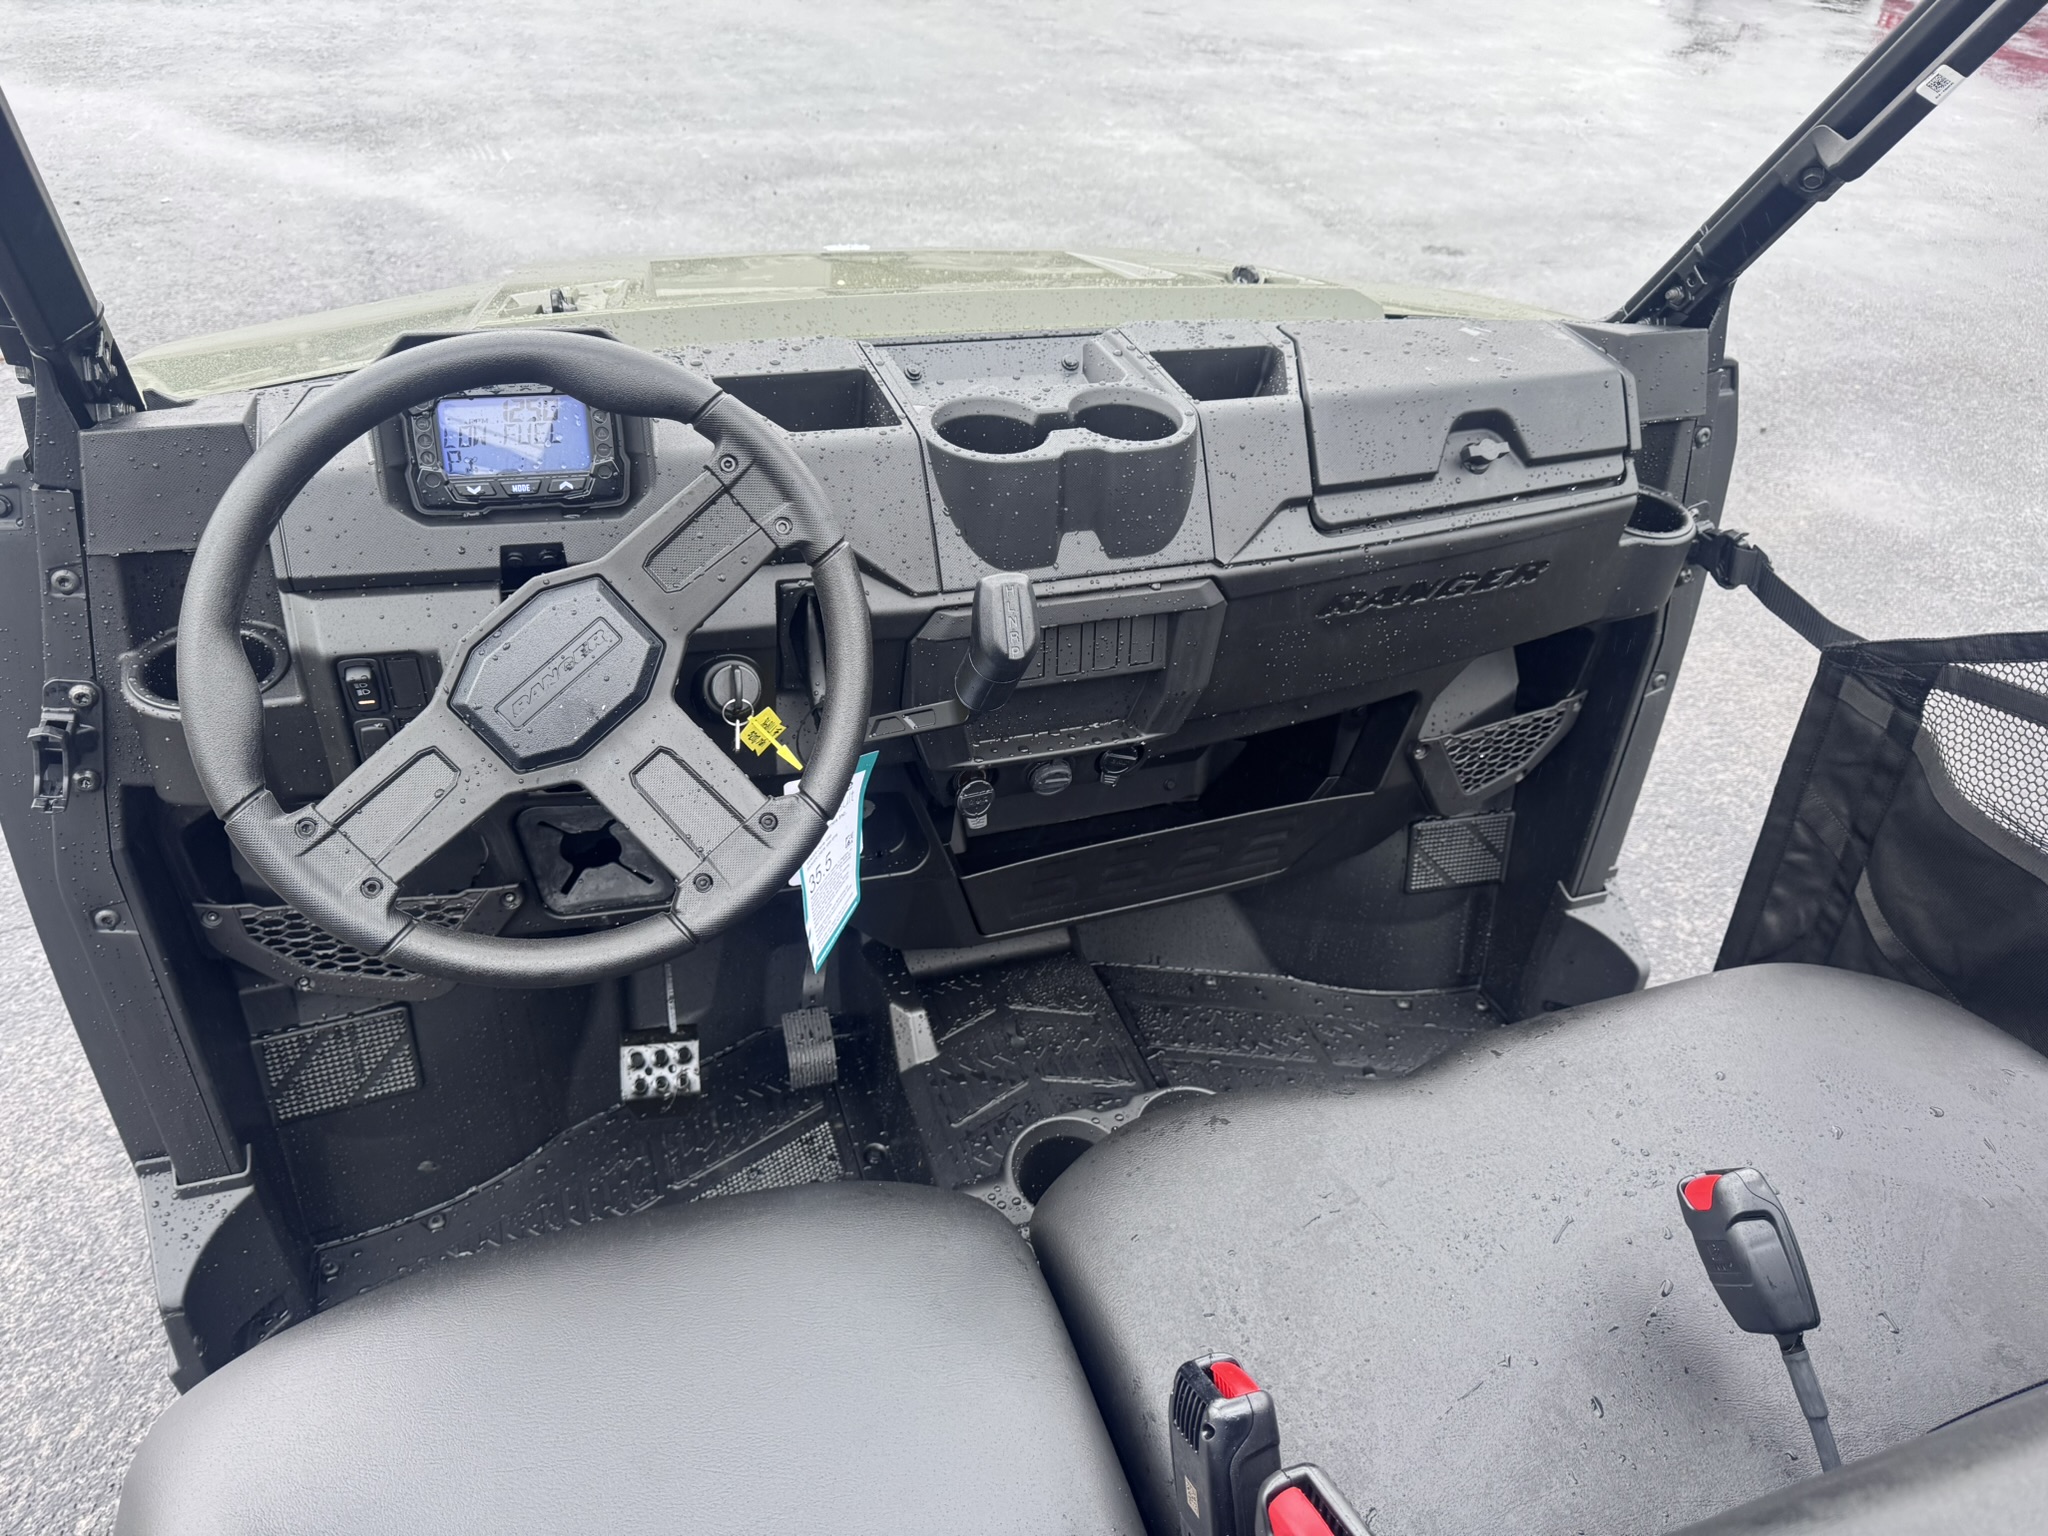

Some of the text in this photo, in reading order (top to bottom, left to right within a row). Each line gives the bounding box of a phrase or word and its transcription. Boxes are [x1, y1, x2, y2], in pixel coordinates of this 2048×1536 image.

[444, 422, 562, 448] LOW FUEL
[511, 484, 531, 493] MODE
[1314, 559, 1551, 619] RANGER
[511, 629, 608, 718] RANGER
[808, 851, 832, 893] 35.5
